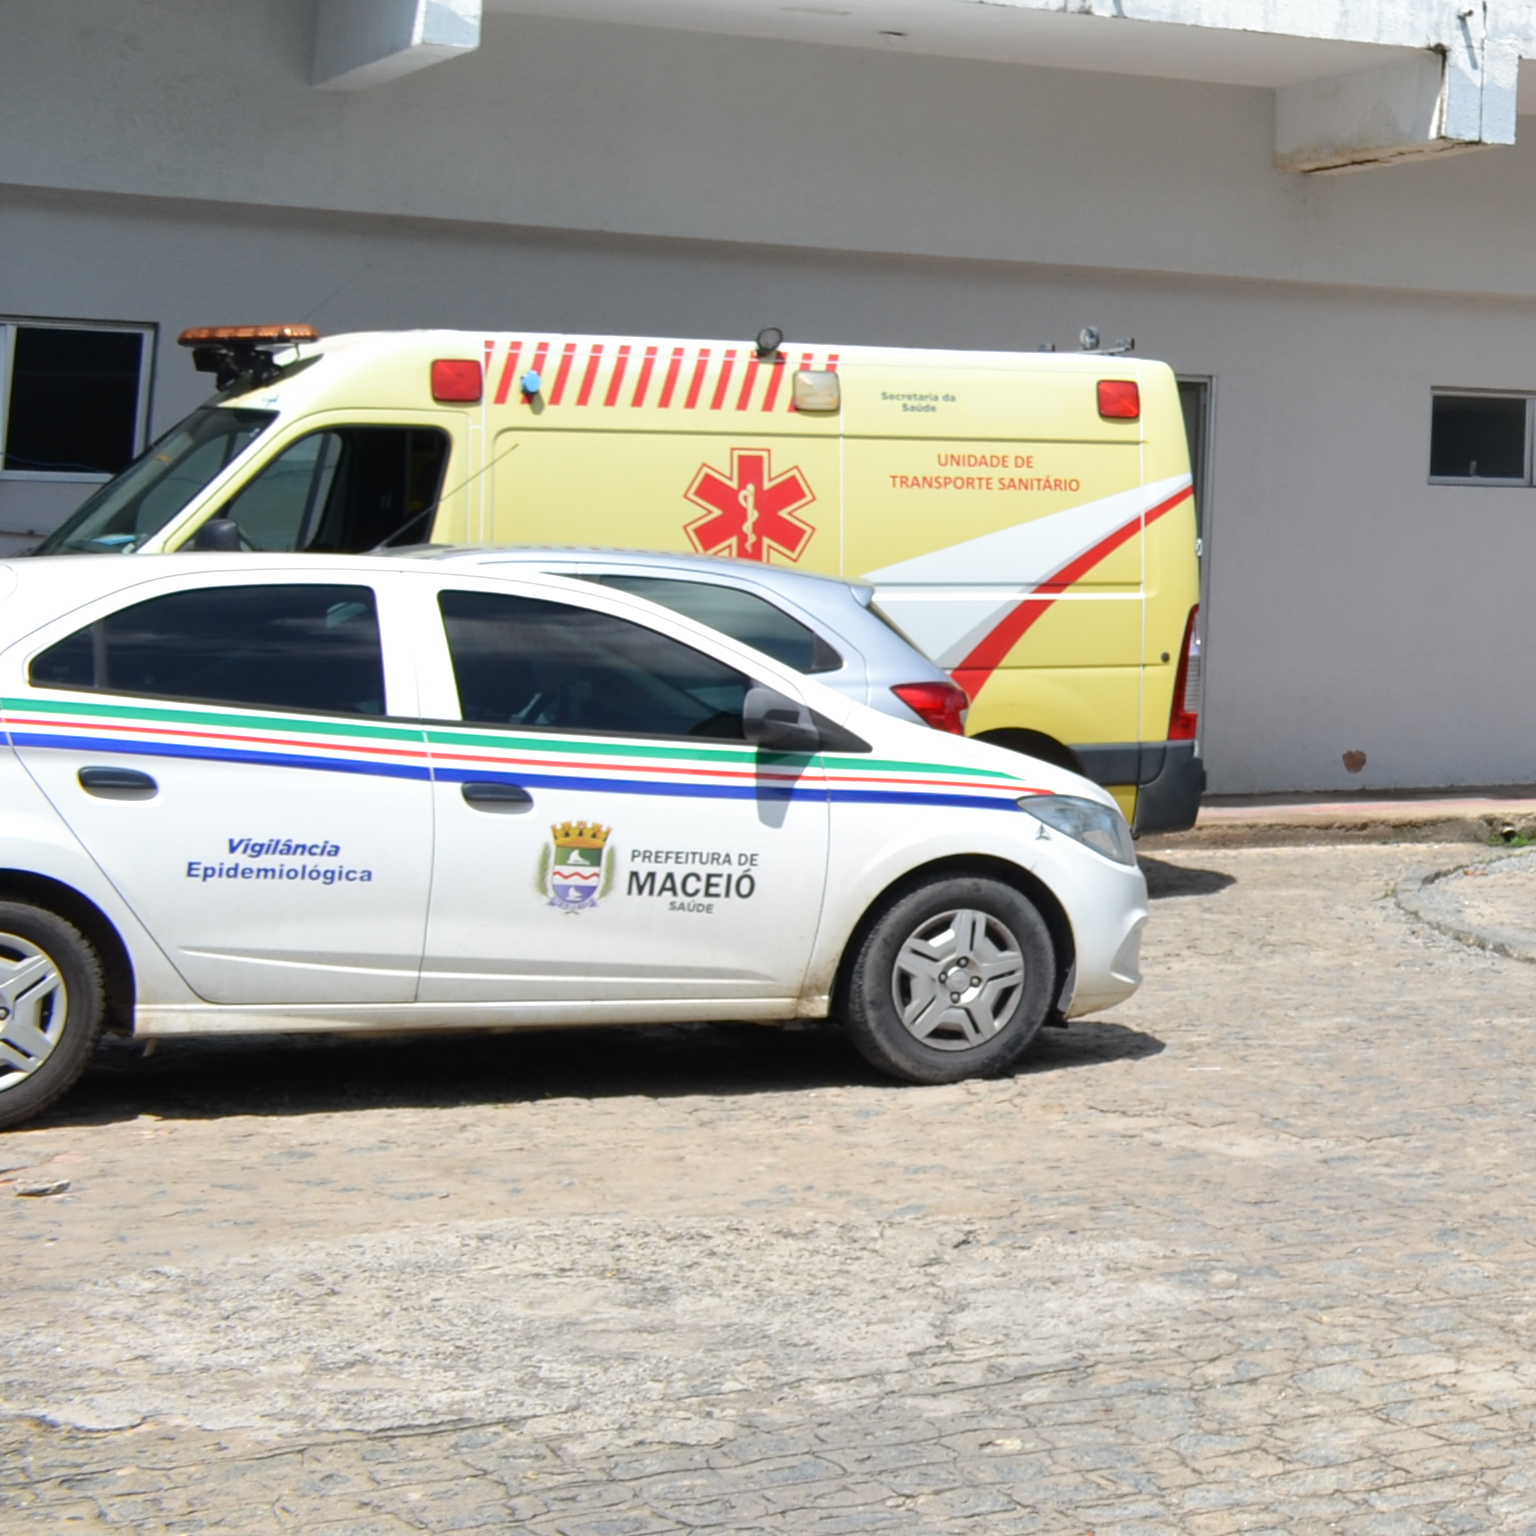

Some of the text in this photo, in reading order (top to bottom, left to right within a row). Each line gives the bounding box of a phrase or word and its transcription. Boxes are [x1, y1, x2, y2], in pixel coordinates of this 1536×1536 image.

[881, 391, 956, 403] Secretaria da
[902, 402, 937, 413] Saúde
[937, 453, 1035, 469] UNIDADE DE
[890, 474, 1081, 493] TRANSPORTE SANITÁRIO
[227, 837, 341, 859] Vigilância
[630, 849, 760, 867] PREFEITURA DE
[185, 861, 373, 886] Epidemiológica
[626, 868, 757, 900] MACEIÓ
[668, 900, 715, 915] SAÚDE
